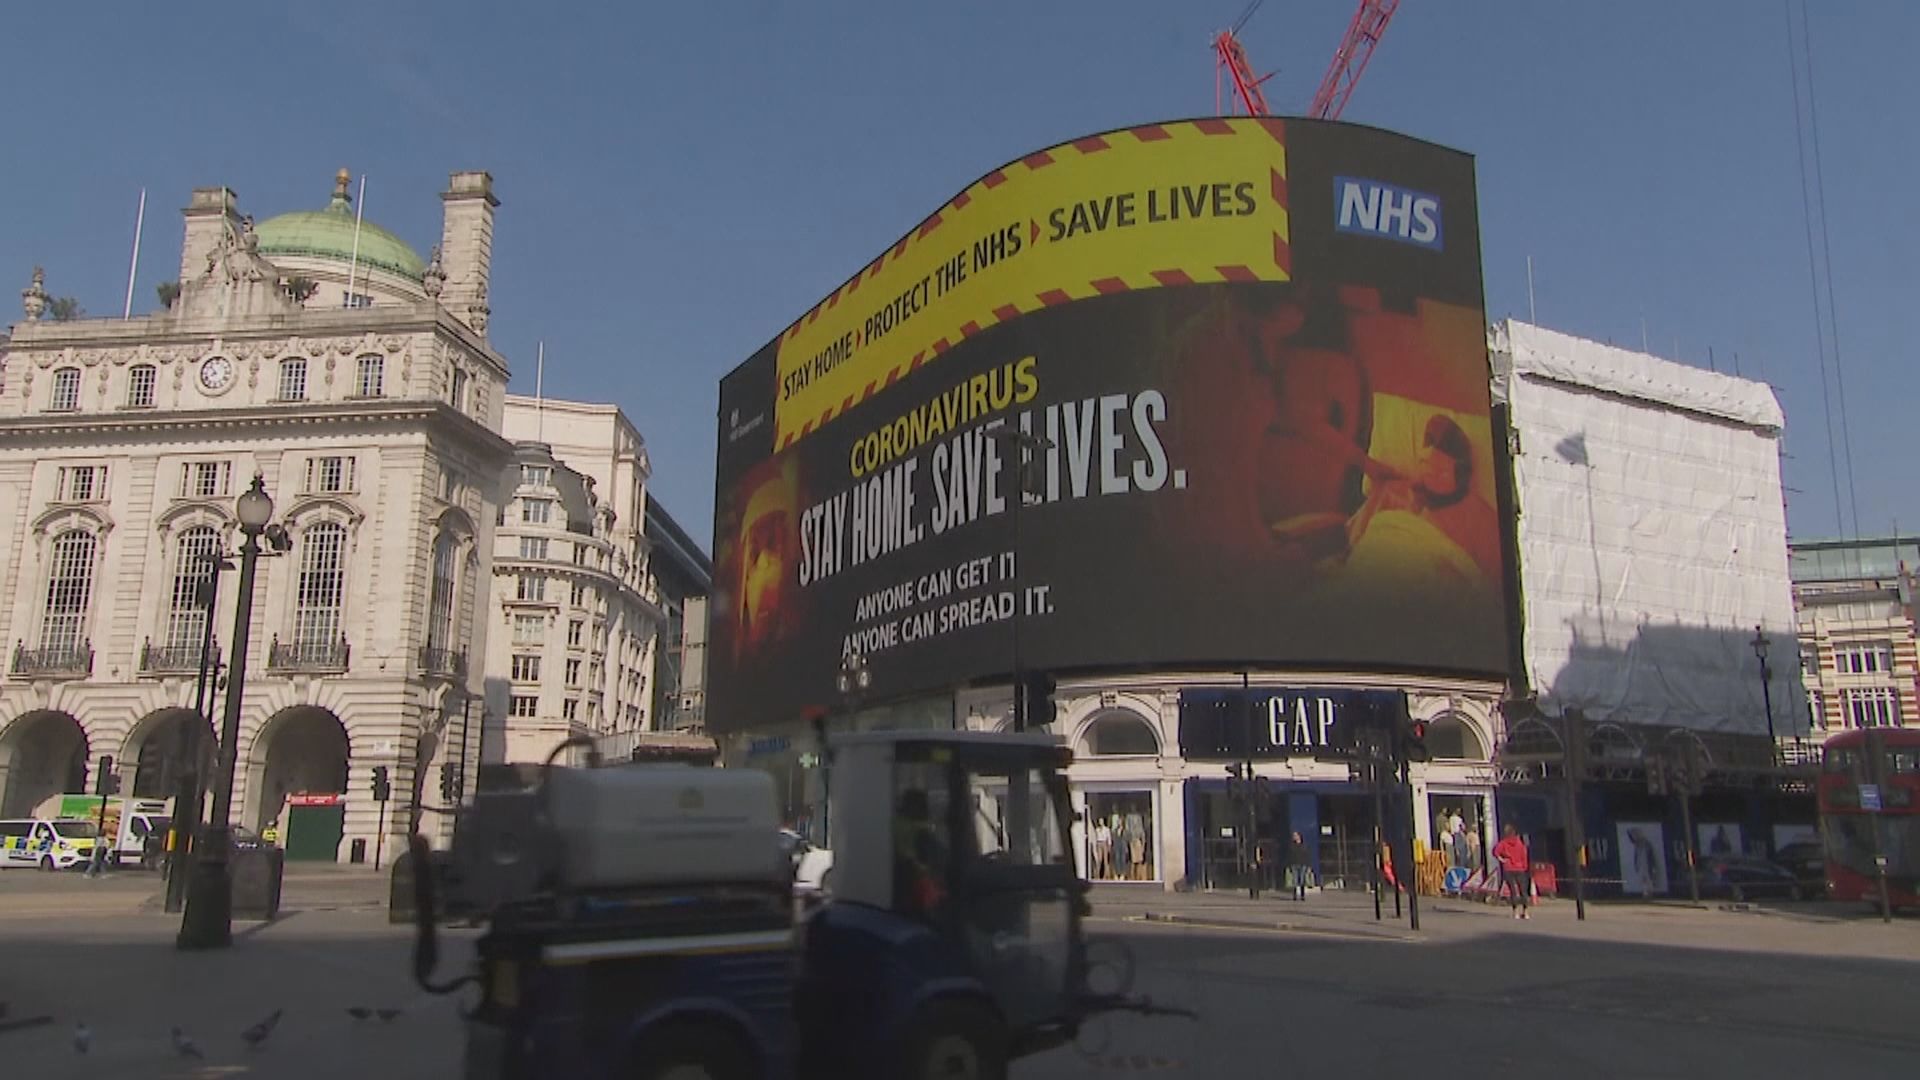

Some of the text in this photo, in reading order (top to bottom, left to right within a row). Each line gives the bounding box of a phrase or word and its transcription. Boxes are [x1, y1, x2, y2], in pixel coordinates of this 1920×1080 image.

[1340, 182, 1437, 243] NHS
[784, 182, 1256, 401] STAY HOME PROTECT THE NHS SAVE LIVES
[850, 356, 1039, 477] CORONAVIRUS
[800, 491, 849, 586] STAY
[851, 457, 925, 567] HOME.
[932, 418, 1006, 535] SAVE
[842, 585, 1054, 659] ANYONE CAN SPREAD IT.
[855, 581, 913, 623] ANYONE
[917, 568, 951, 601] CAN
[956, 556, 993, 590] GET
[1268, 696, 1334, 746] GAP
